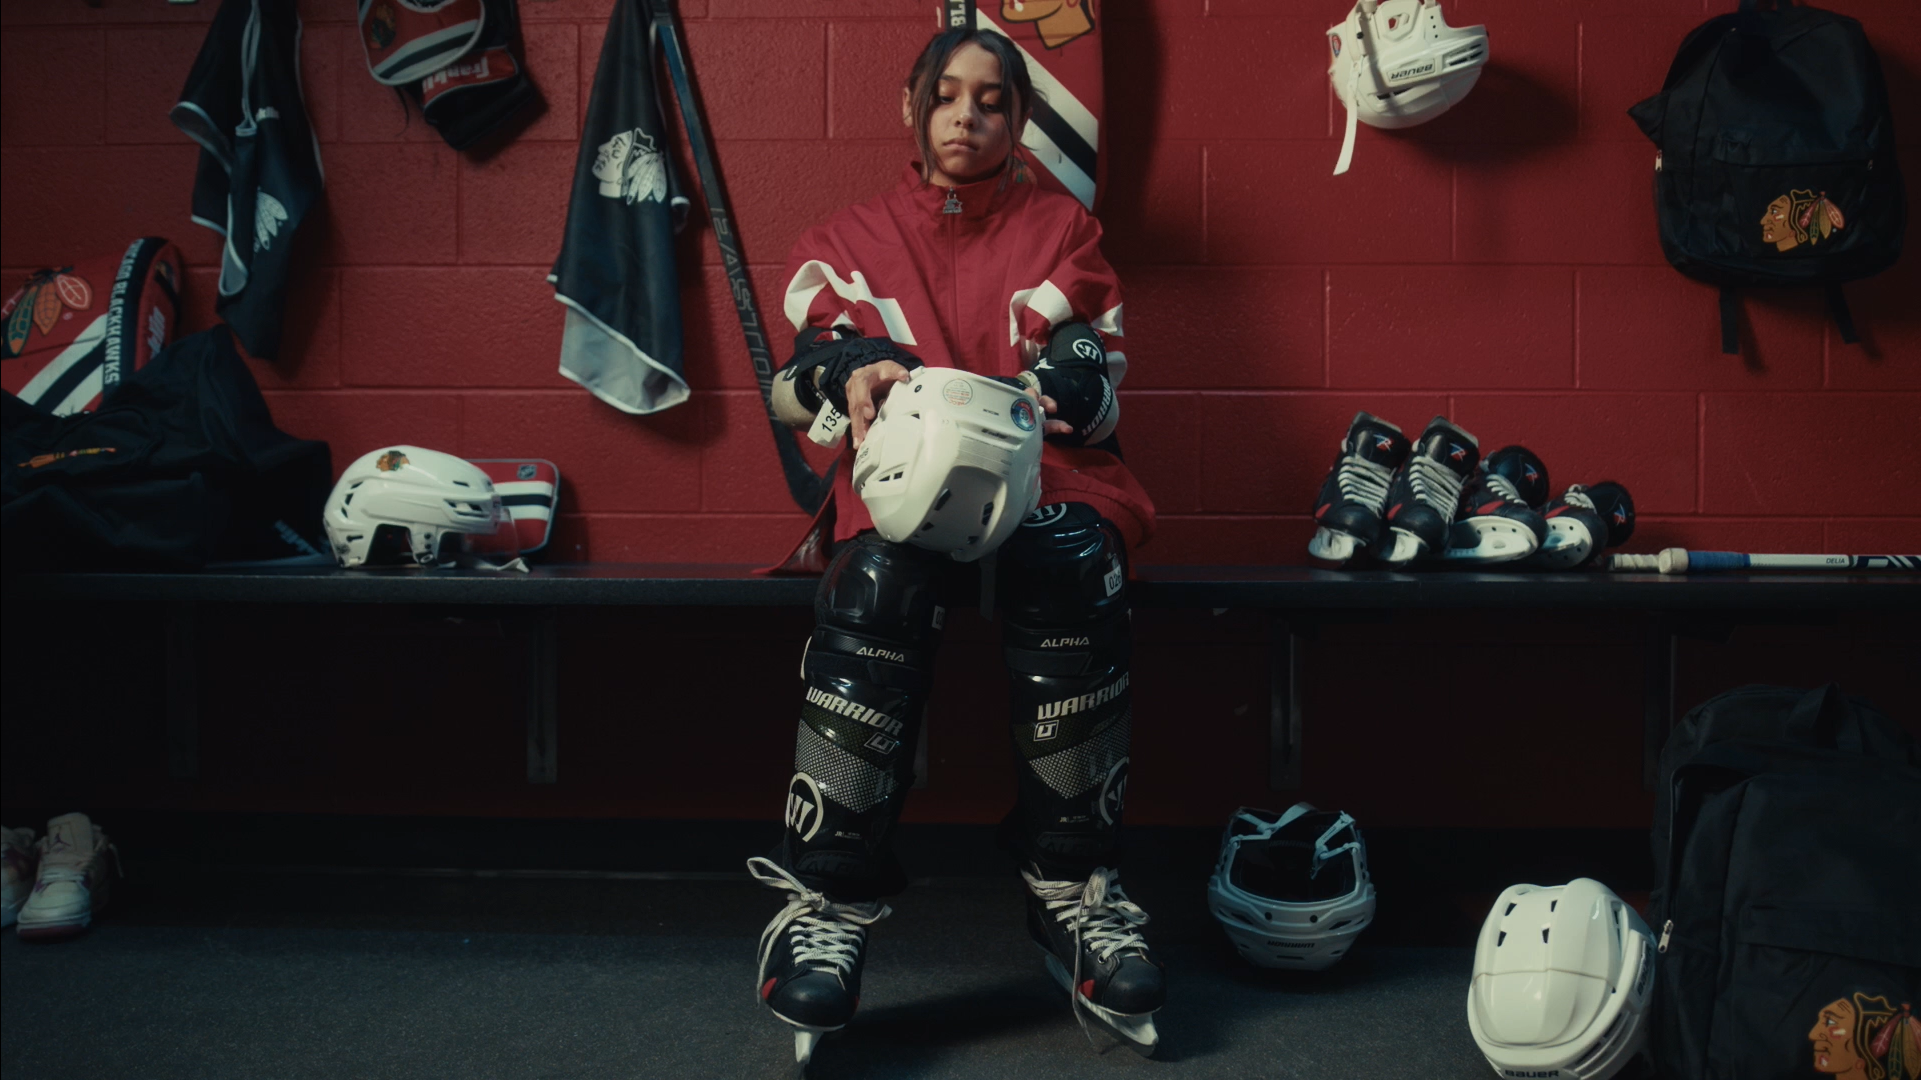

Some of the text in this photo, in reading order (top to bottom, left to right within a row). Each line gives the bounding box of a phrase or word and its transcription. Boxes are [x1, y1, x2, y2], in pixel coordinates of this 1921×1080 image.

[950, 0, 966, 27] BL
[104, 280, 130, 386] BLACKHAWKS
[821, 408, 843, 433] 135
[1825, 557, 1846, 565] DELIA
[856, 646, 905, 663] ALPHA
[1040, 636, 1090, 648] ALPHA
[1037, 671, 1130, 721] WARRIOR
[805, 686, 904, 736] WARRIOR
